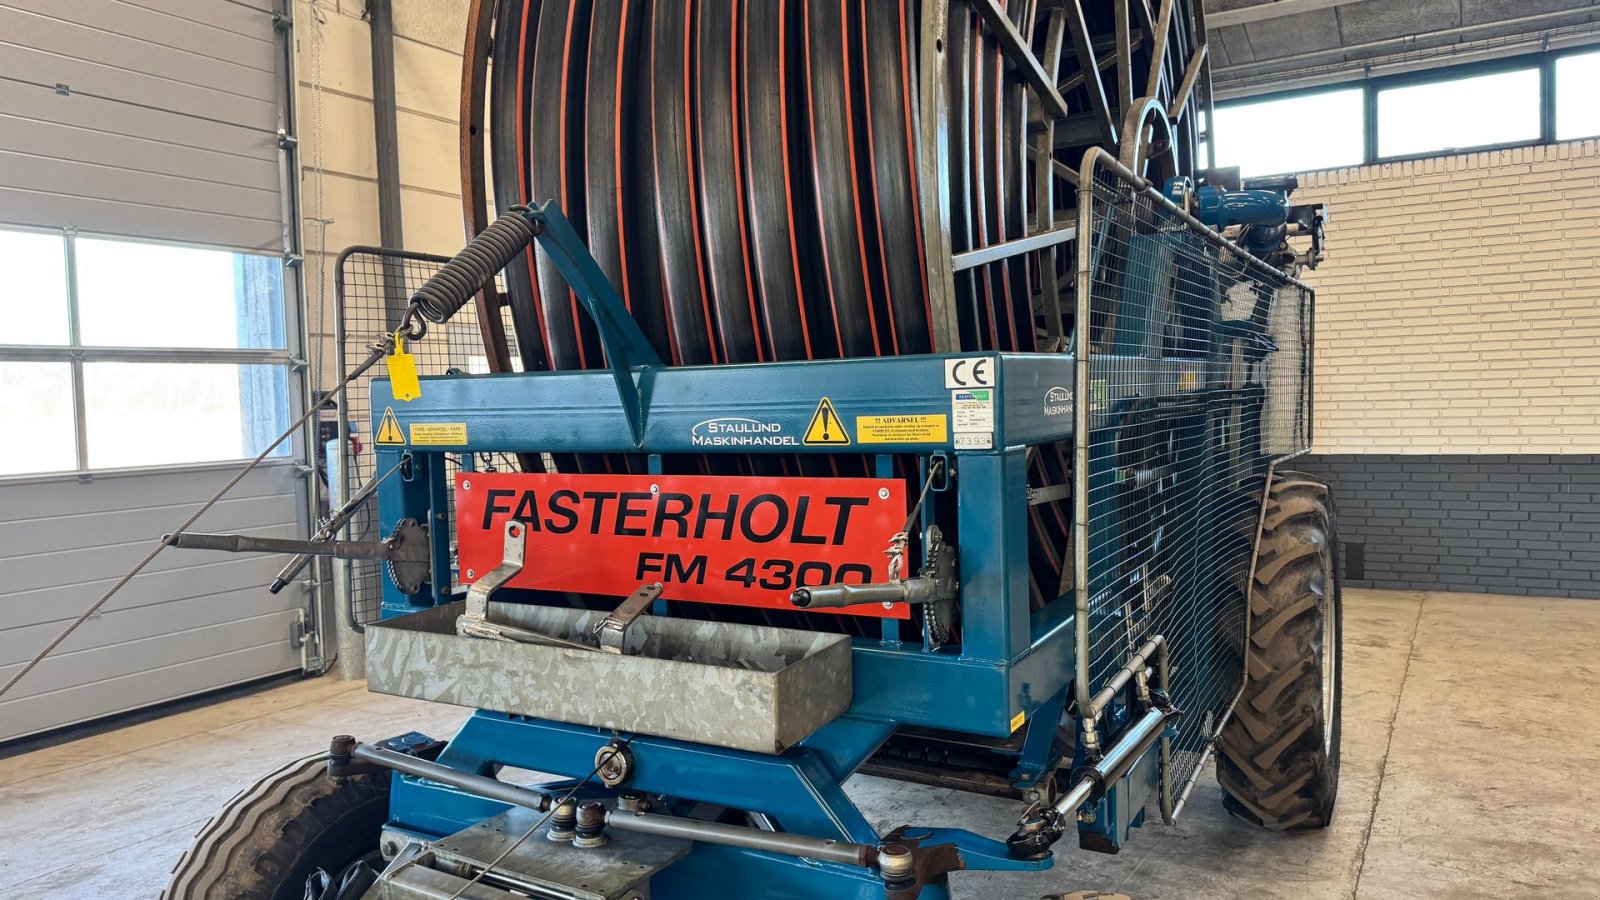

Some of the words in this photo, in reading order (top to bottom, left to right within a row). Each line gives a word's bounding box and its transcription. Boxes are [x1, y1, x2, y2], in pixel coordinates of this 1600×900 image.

[952, 359, 987, 386] CE
[1043, 404, 1073, 416] MASKINHAN
[708, 422, 781, 433] STAULUND
[692, 435, 800, 446] MASKINHANDEL
[482, 489, 869, 545] FASTERHOLT
[636, 552, 707, 584] FM
[724, 558, 872, 590] 4300
